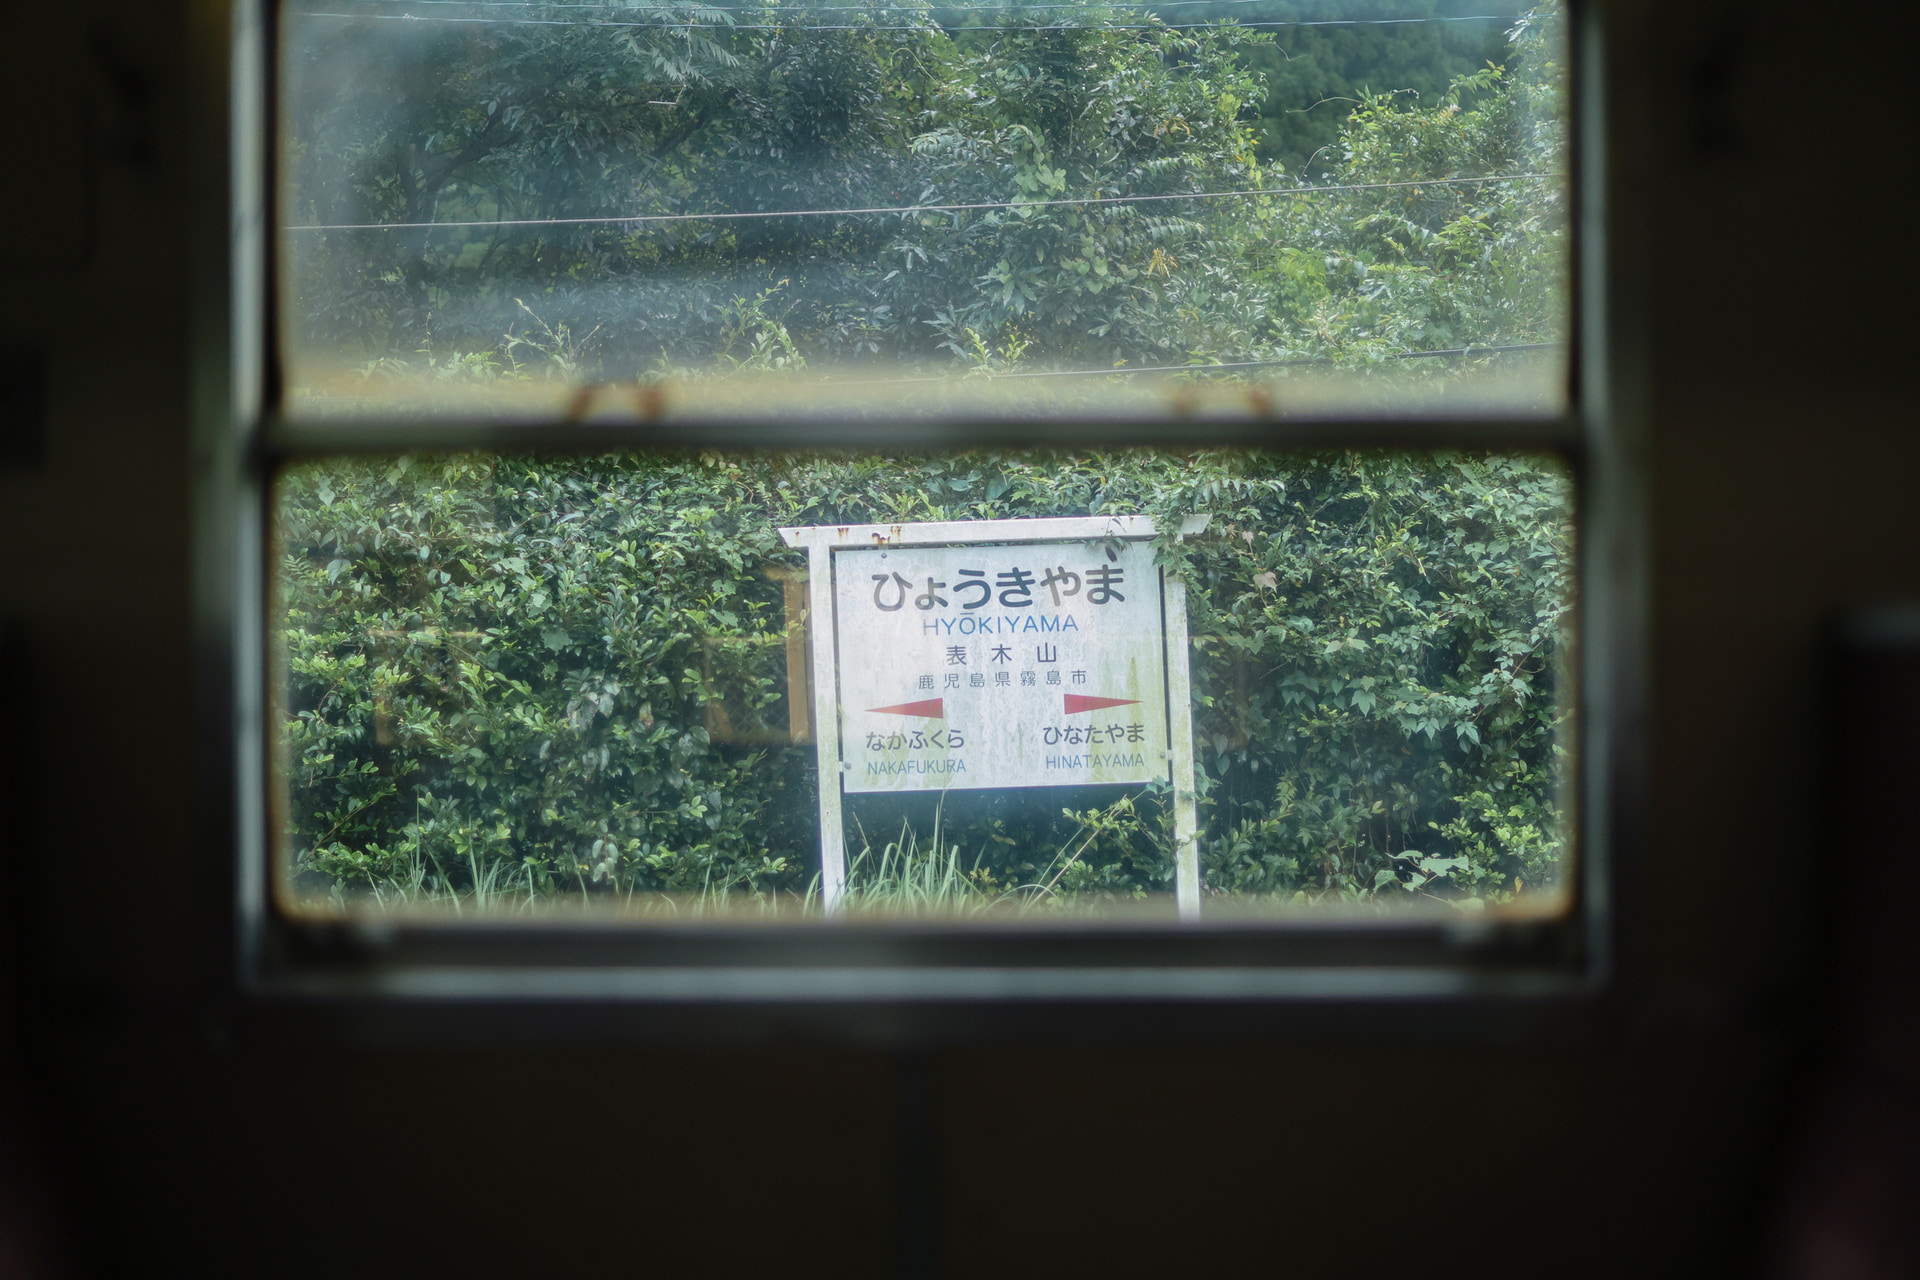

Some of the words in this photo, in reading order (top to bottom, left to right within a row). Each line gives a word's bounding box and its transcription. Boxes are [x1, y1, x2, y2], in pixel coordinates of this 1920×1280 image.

[872, 564, 1125, 612] ひょうきやま
[923, 612, 1079, 636] HYŌKIYAMA
[946, 642, 1057, 666] 表木山
[918, 669, 1087, 690] 鹿児島県霧島市
[866, 729, 965, 751] なかふくら
[1043, 723, 1145, 746] ひなたやま
[867, 760, 966, 775] NAKAFUKURA
[1046, 753, 1145, 769] HINATAYAMA
